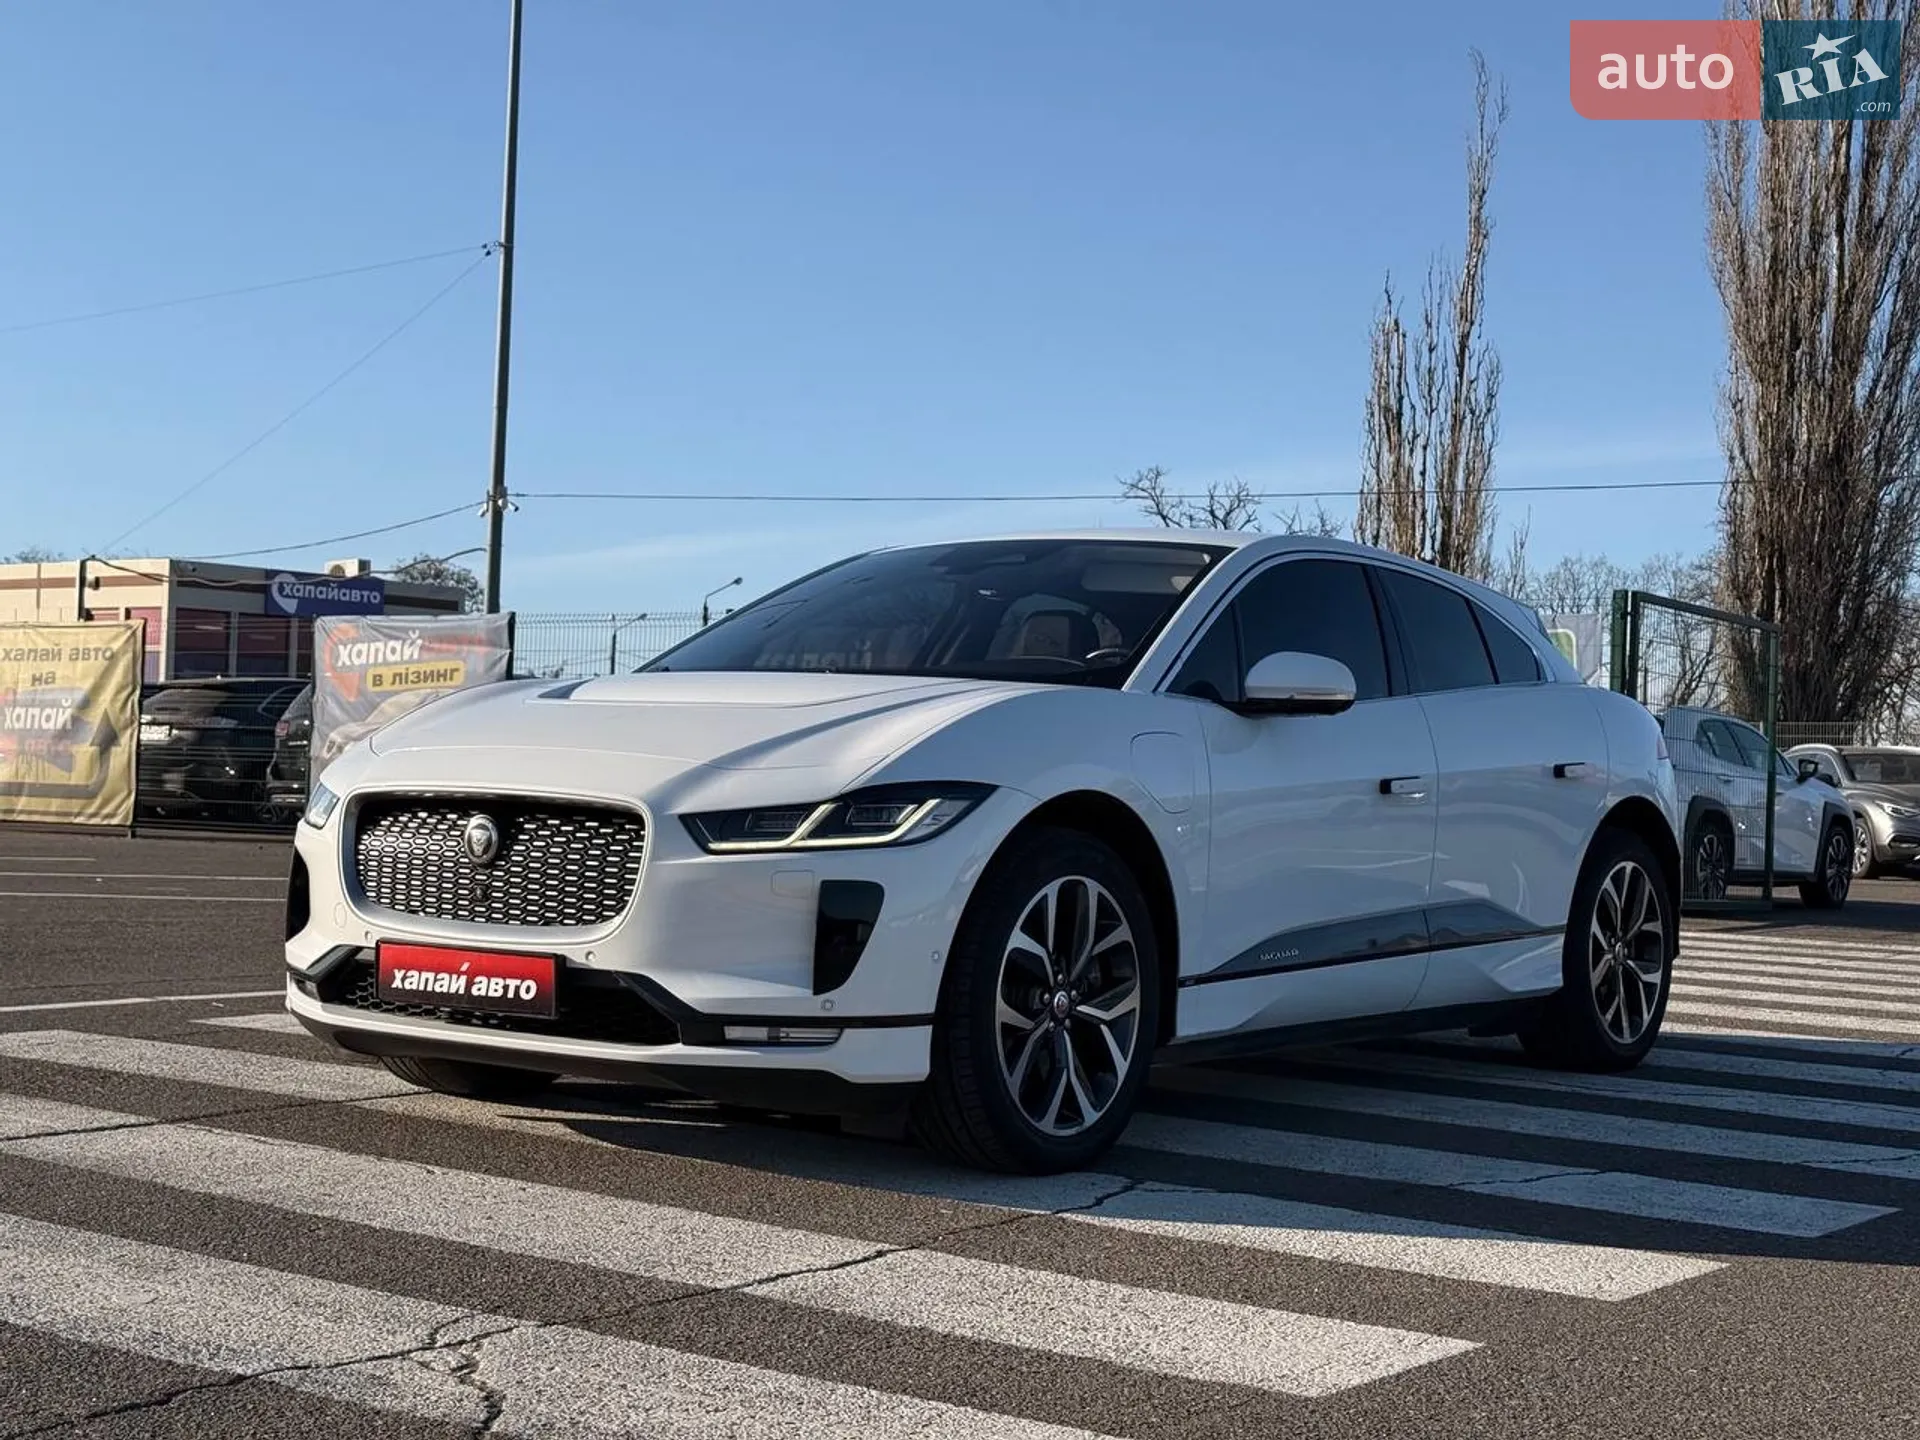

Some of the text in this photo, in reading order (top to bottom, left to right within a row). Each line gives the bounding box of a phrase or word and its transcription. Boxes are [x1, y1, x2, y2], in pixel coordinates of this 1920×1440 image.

[2, 642, 114, 662] хапай авто
[337, 630, 423, 667] хапай
[31, 671, 56, 686] на
[372, 666, 460, 687] в лізинг
[4, 697, 72, 729] хапай
[471, 975, 537, 1000] авто
